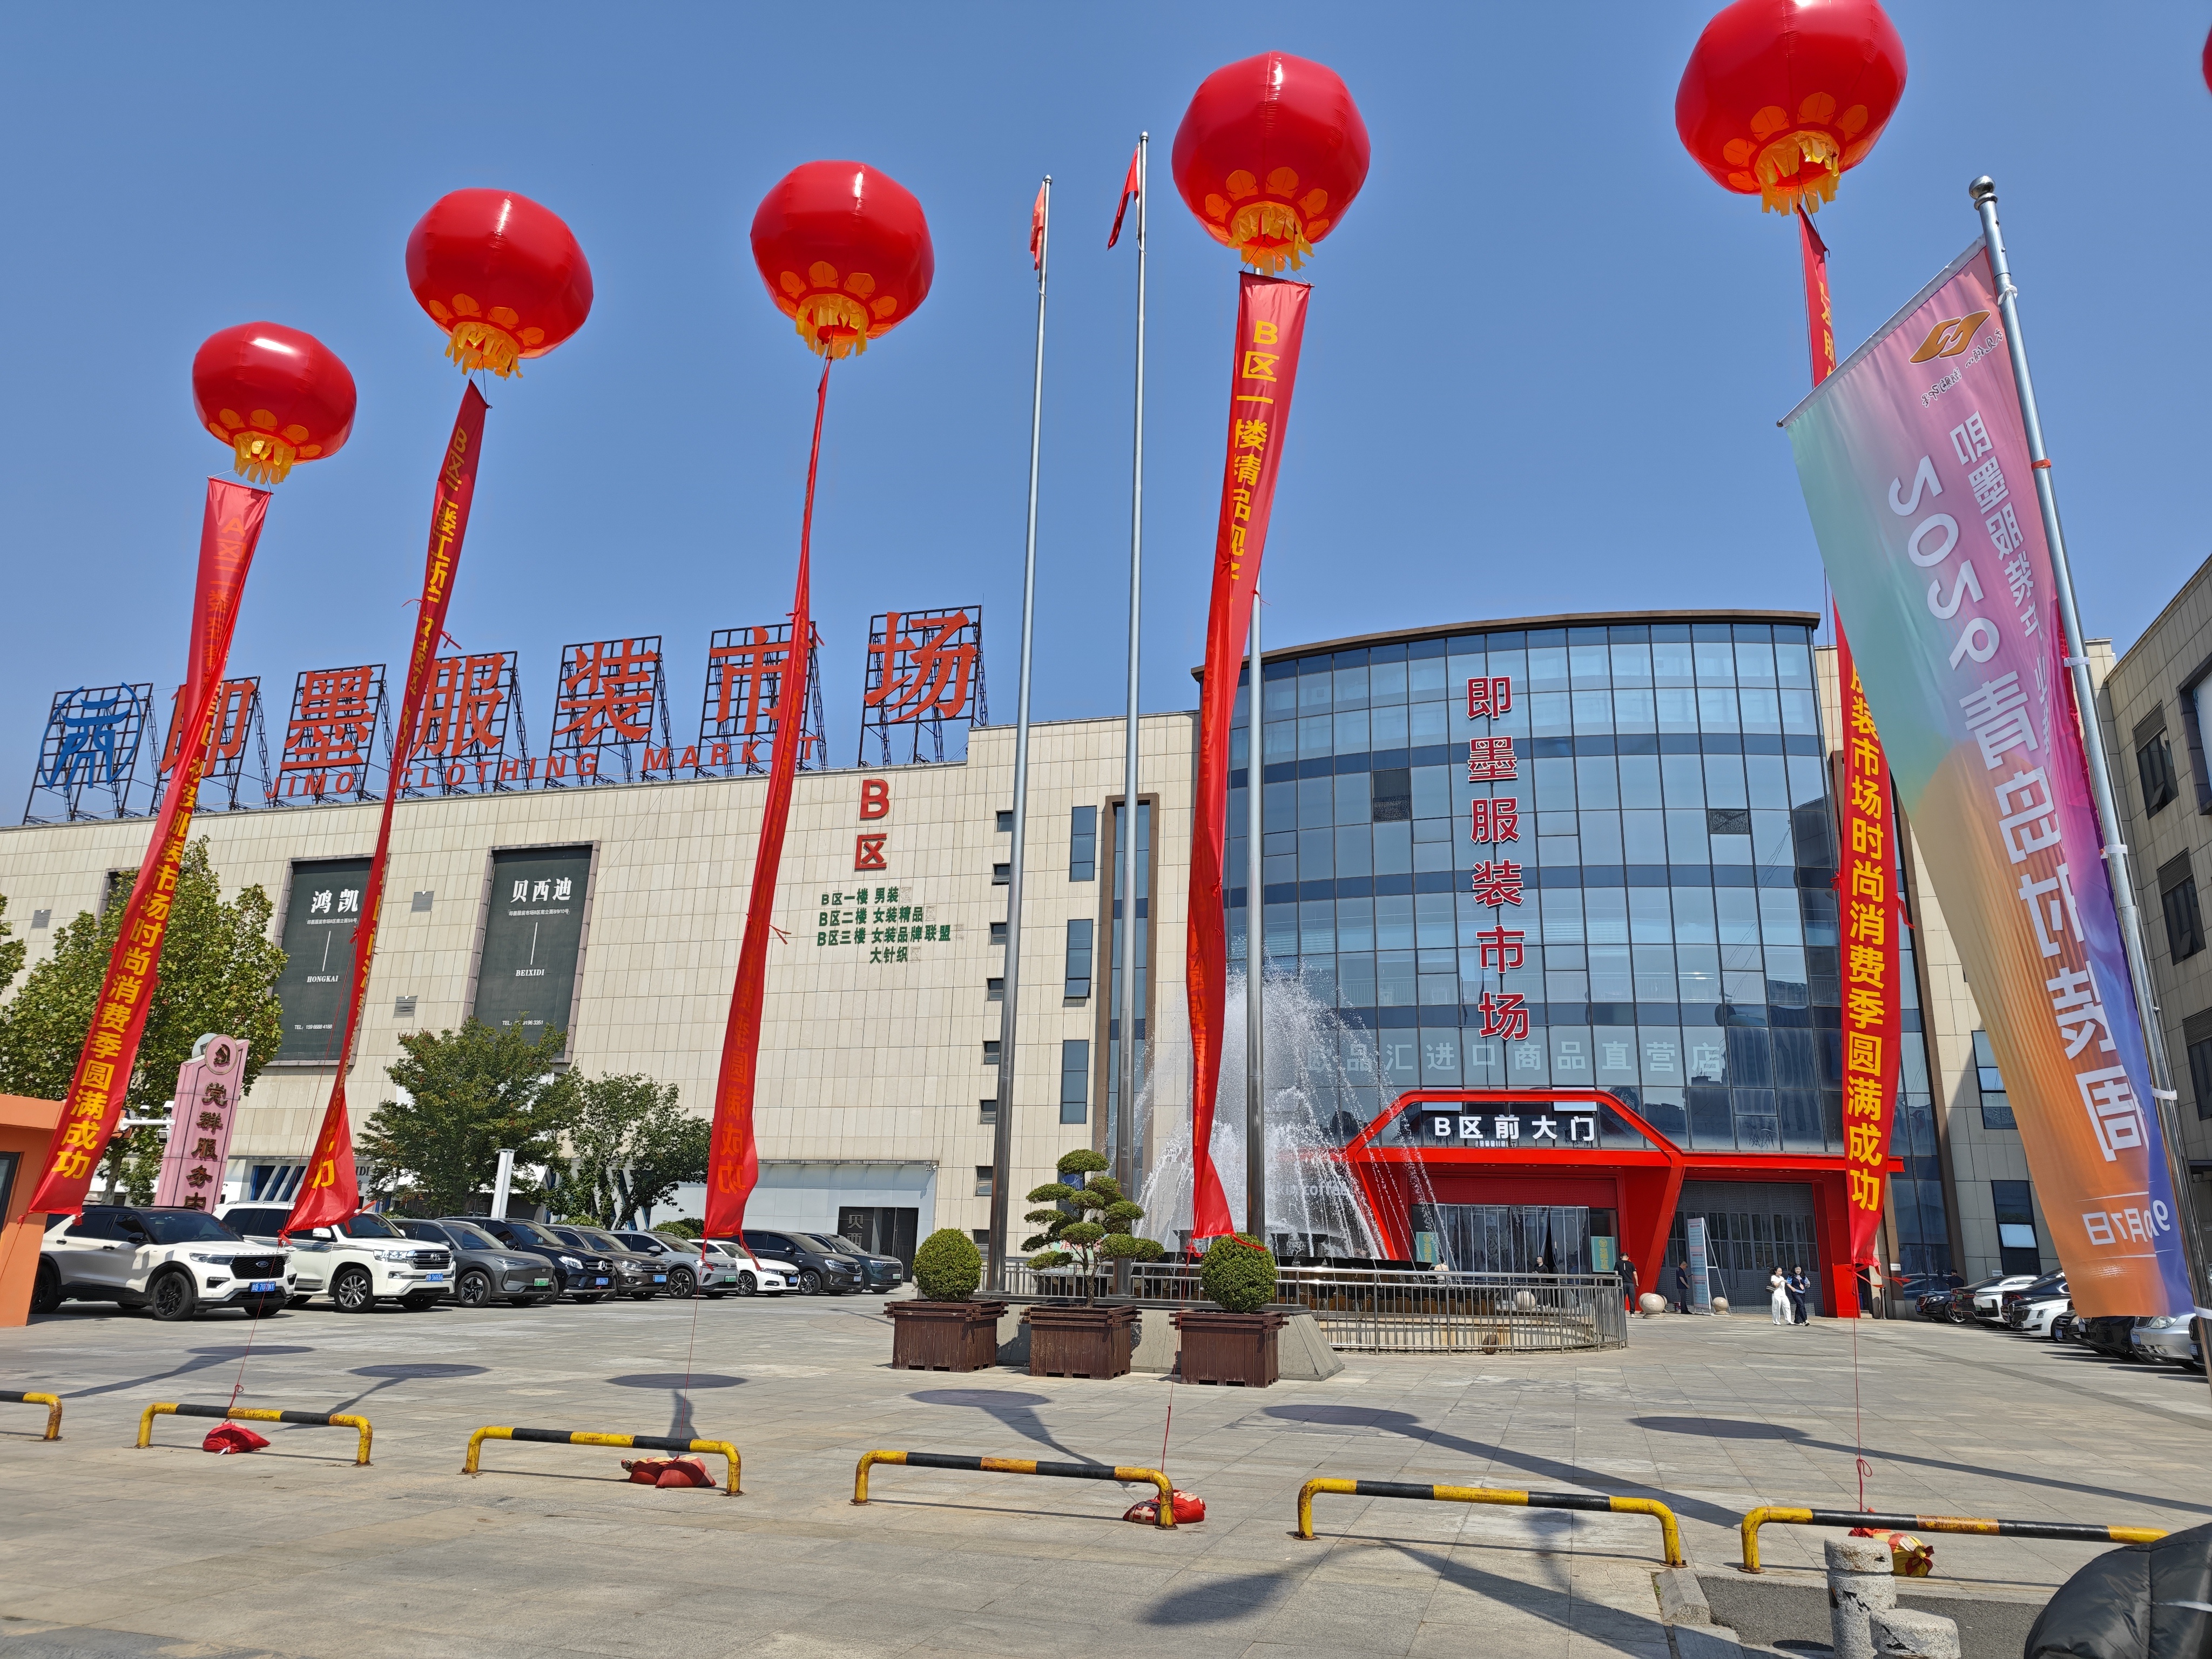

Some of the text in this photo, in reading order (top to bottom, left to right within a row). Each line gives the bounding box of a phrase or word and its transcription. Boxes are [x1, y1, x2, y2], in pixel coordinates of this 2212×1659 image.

[265, 736, 819, 799] JIMO CLOTHING MARKT
[855, 778, 890, 871] B区
[1467, 676, 1529, 1041] 即墨服装市场
[311, 888, 359, 913] 鸿凯
[510, 877, 572, 903] 贝西迪
[821, 886, 899, 906] B区一楼 男装
[819, 906, 923, 926] B区二楼 女装精品
[817, 924, 950, 946] B区三楼 女装品牌联盟
[869, 946, 908, 964] 大针织
[1434, 1115, 1594, 1141] B区前大门
